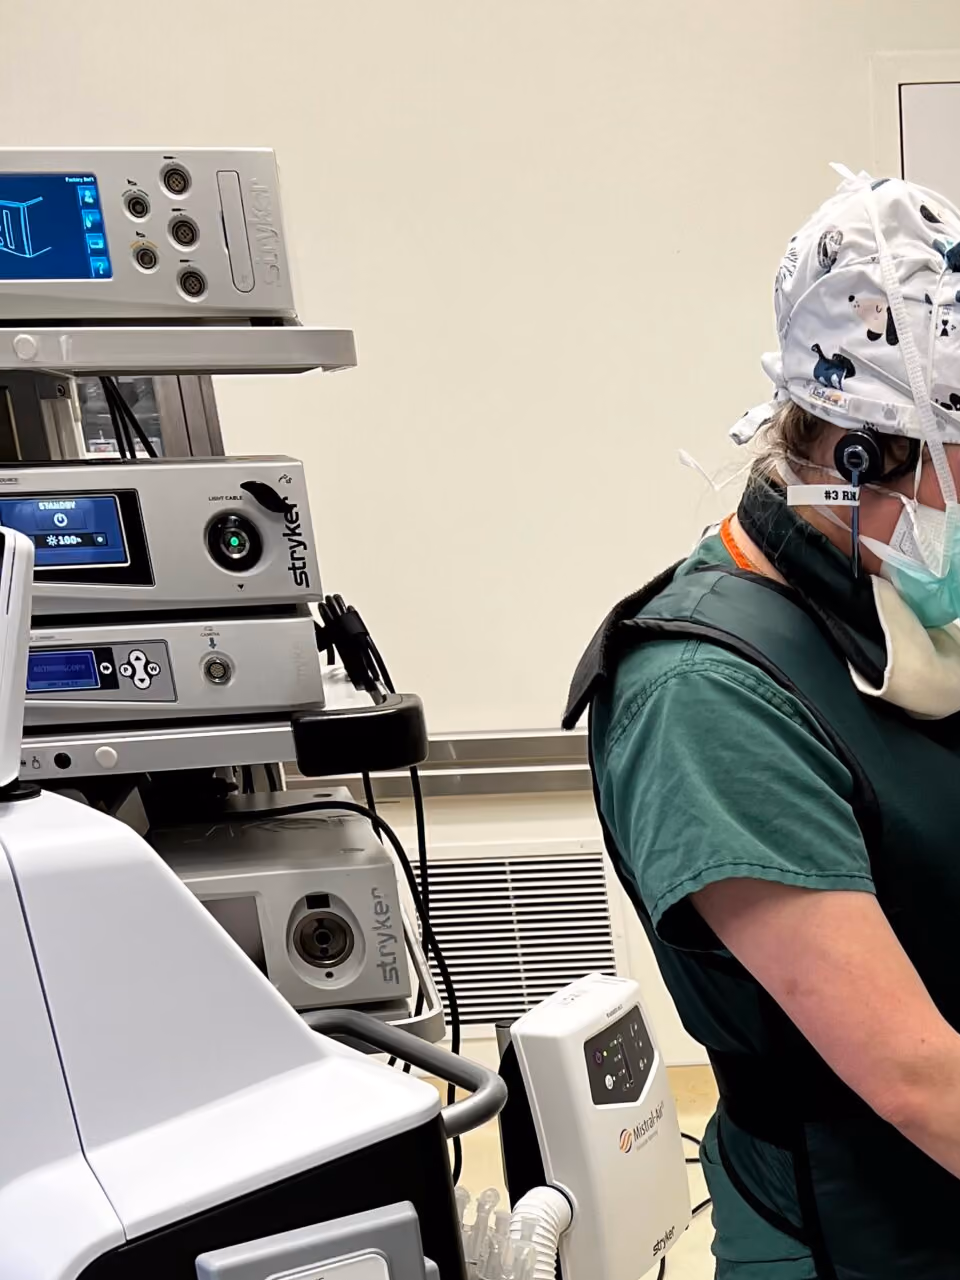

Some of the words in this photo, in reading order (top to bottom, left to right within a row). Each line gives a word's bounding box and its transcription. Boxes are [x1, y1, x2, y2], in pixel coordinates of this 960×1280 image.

[249, 177, 280, 288] stryker
[38, 500, 76, 511] STANDBY
[282, 495, 310, 589] stryker
[371, 886, 400, 985] stryker
[652, 1225, 675, 1257] stryker
